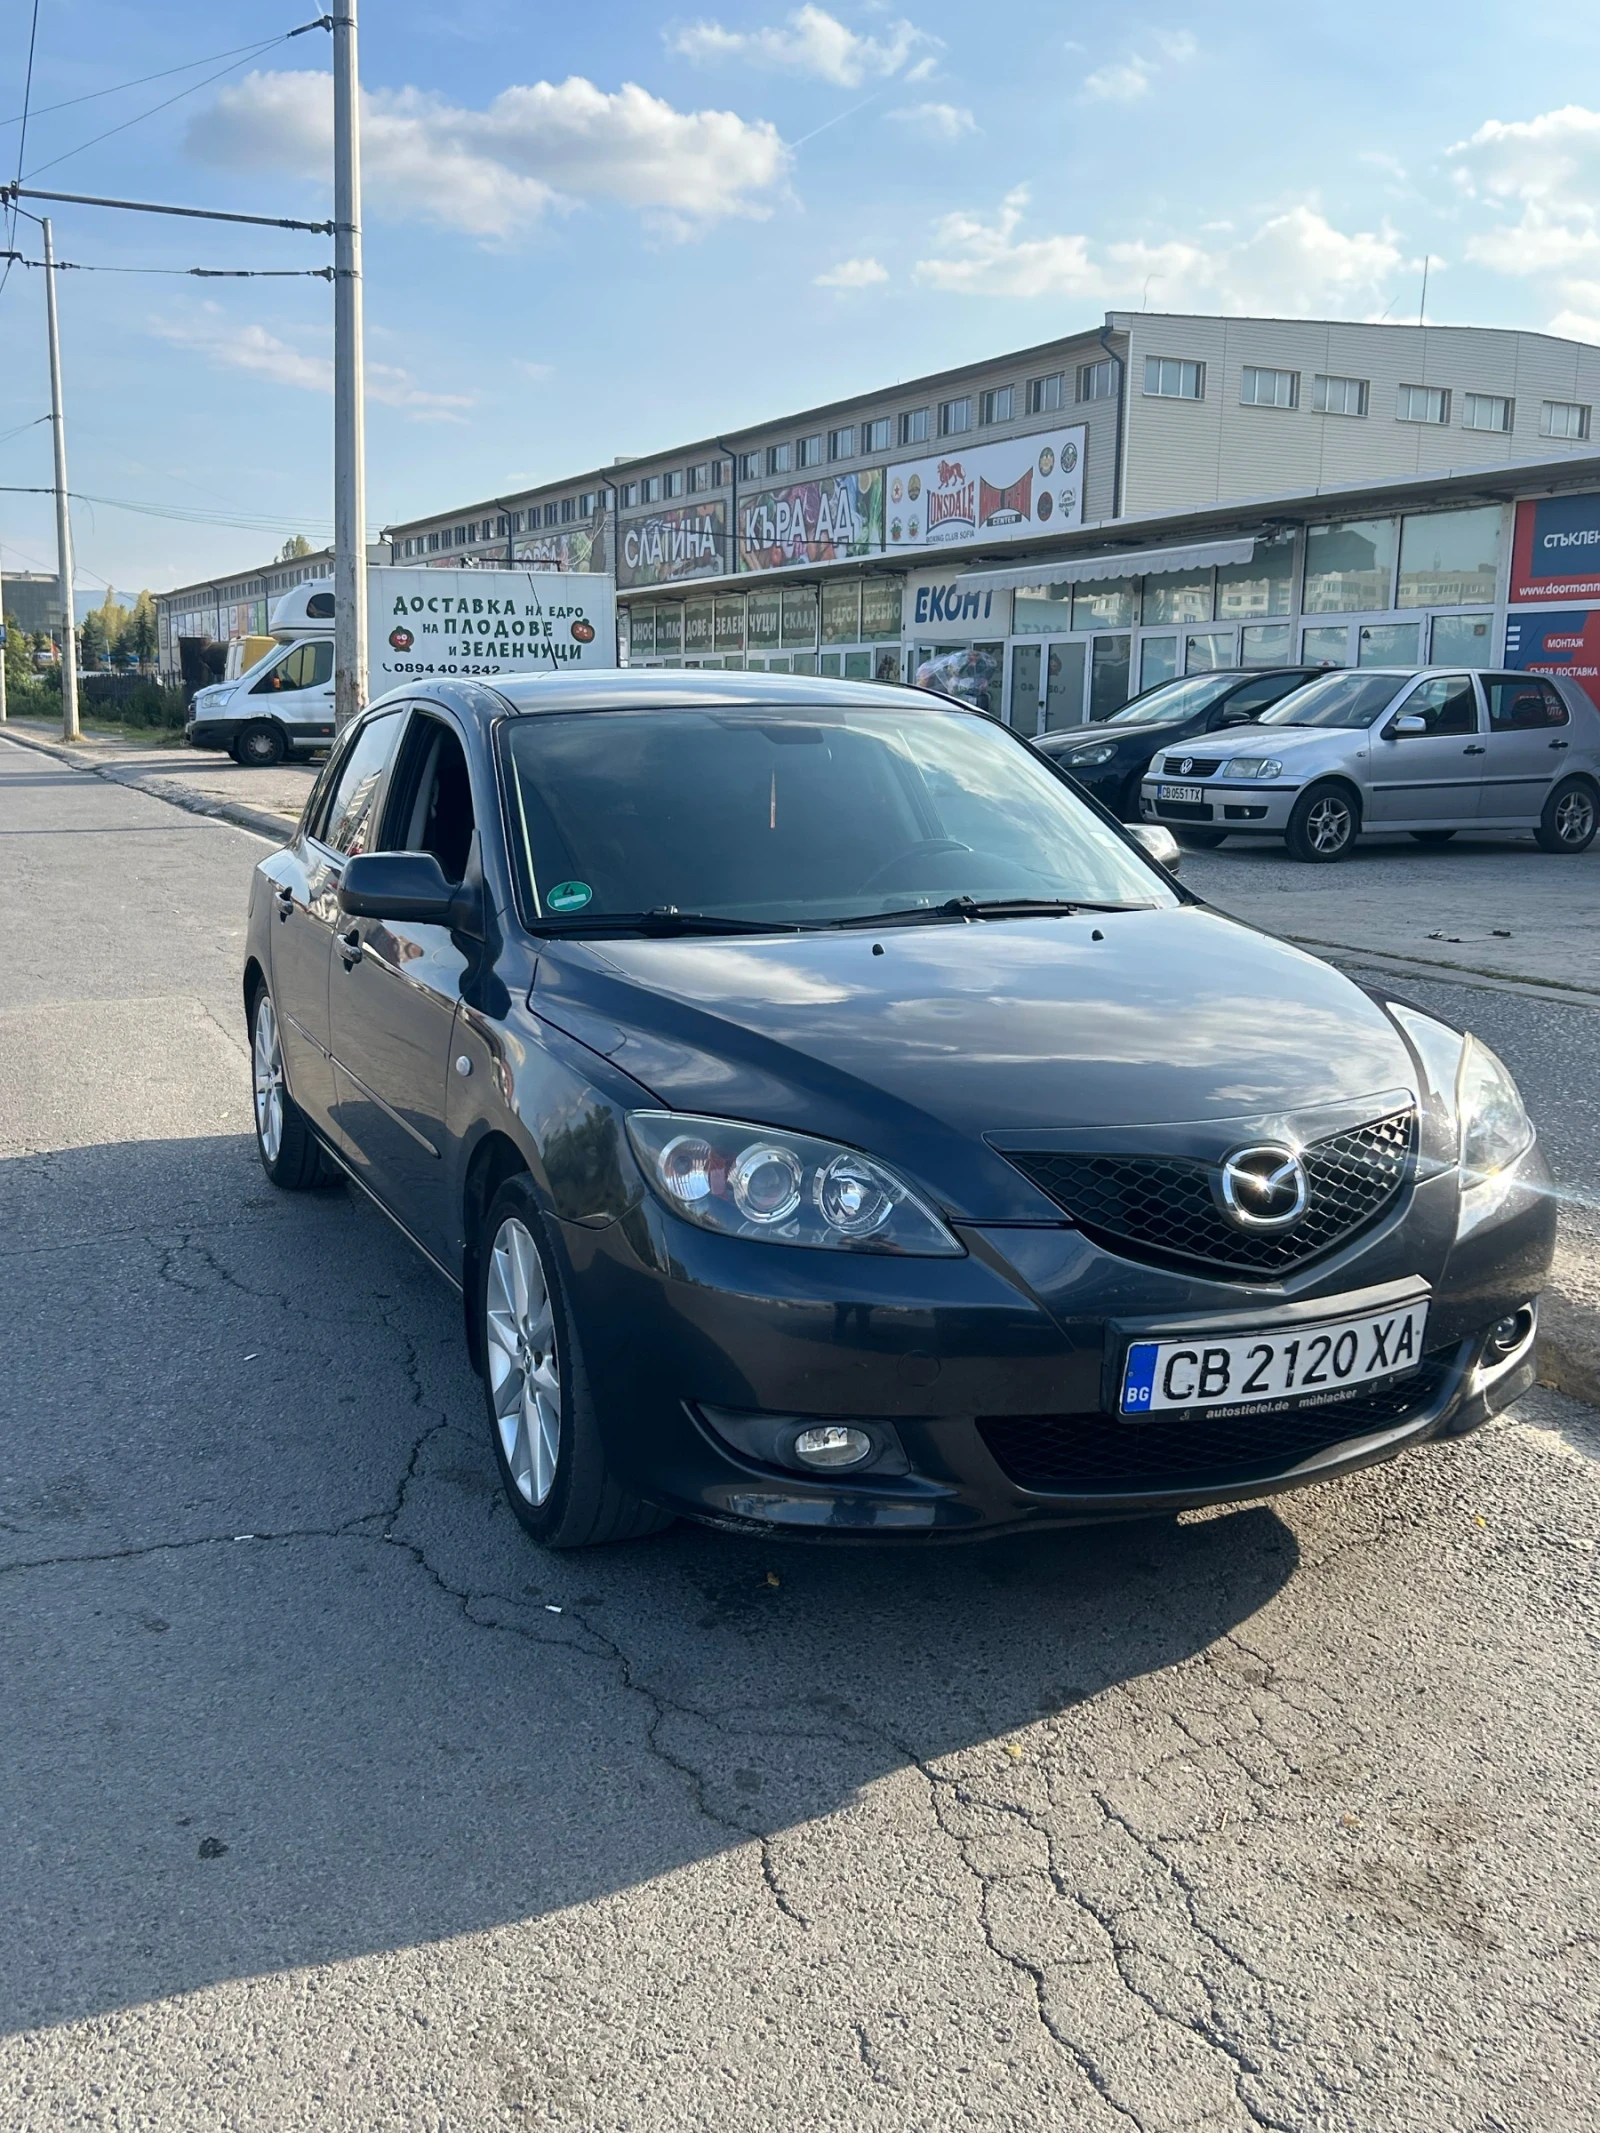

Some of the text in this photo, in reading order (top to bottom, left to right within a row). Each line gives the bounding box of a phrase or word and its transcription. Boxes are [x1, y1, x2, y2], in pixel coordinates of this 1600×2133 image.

[926, 480, 975, 531] LONSDALE
[744, 499, 806, 553] КЪРА
[815, 487, 857, 549] АД
[624, 515, 716, 569] СЛАТИНА
[945, 532, 958, 541] CLUB
[959, 530, 975, 539] SOFIA
[1519, 583, 1600, 596] www.doormann
[393, 596, 583, 618] ДОСТАВКА НА ЕДРО
[423, 618, 553, 638] НА ПЛОДОВЕ
[633, 623, 654, 641] ВНОС
[783, 610, 815, 631] СКЛАД
[832, 606, 853, 626] ЕДРО
[863, 602, 900, 624] ДРЕБНО
[461, 640, 582, 661] ЗЕЛЕНЧУЦИ
[1547, 638, 1584, 648] МОНТАЖ
[394, 663, 500, 675] 0894 40 4242
[1172, 787, 1188, 800] 0551
[1190, 788, 1201, 801] TX
[562, 883, 575, 896] 4
[1163, 1313, 1412, 1400] CB 2120 XA
[1127, 1387, 1149, 1403] BG
[1205, 1387, 1357, 1419] autostiefel.de mühlacker
